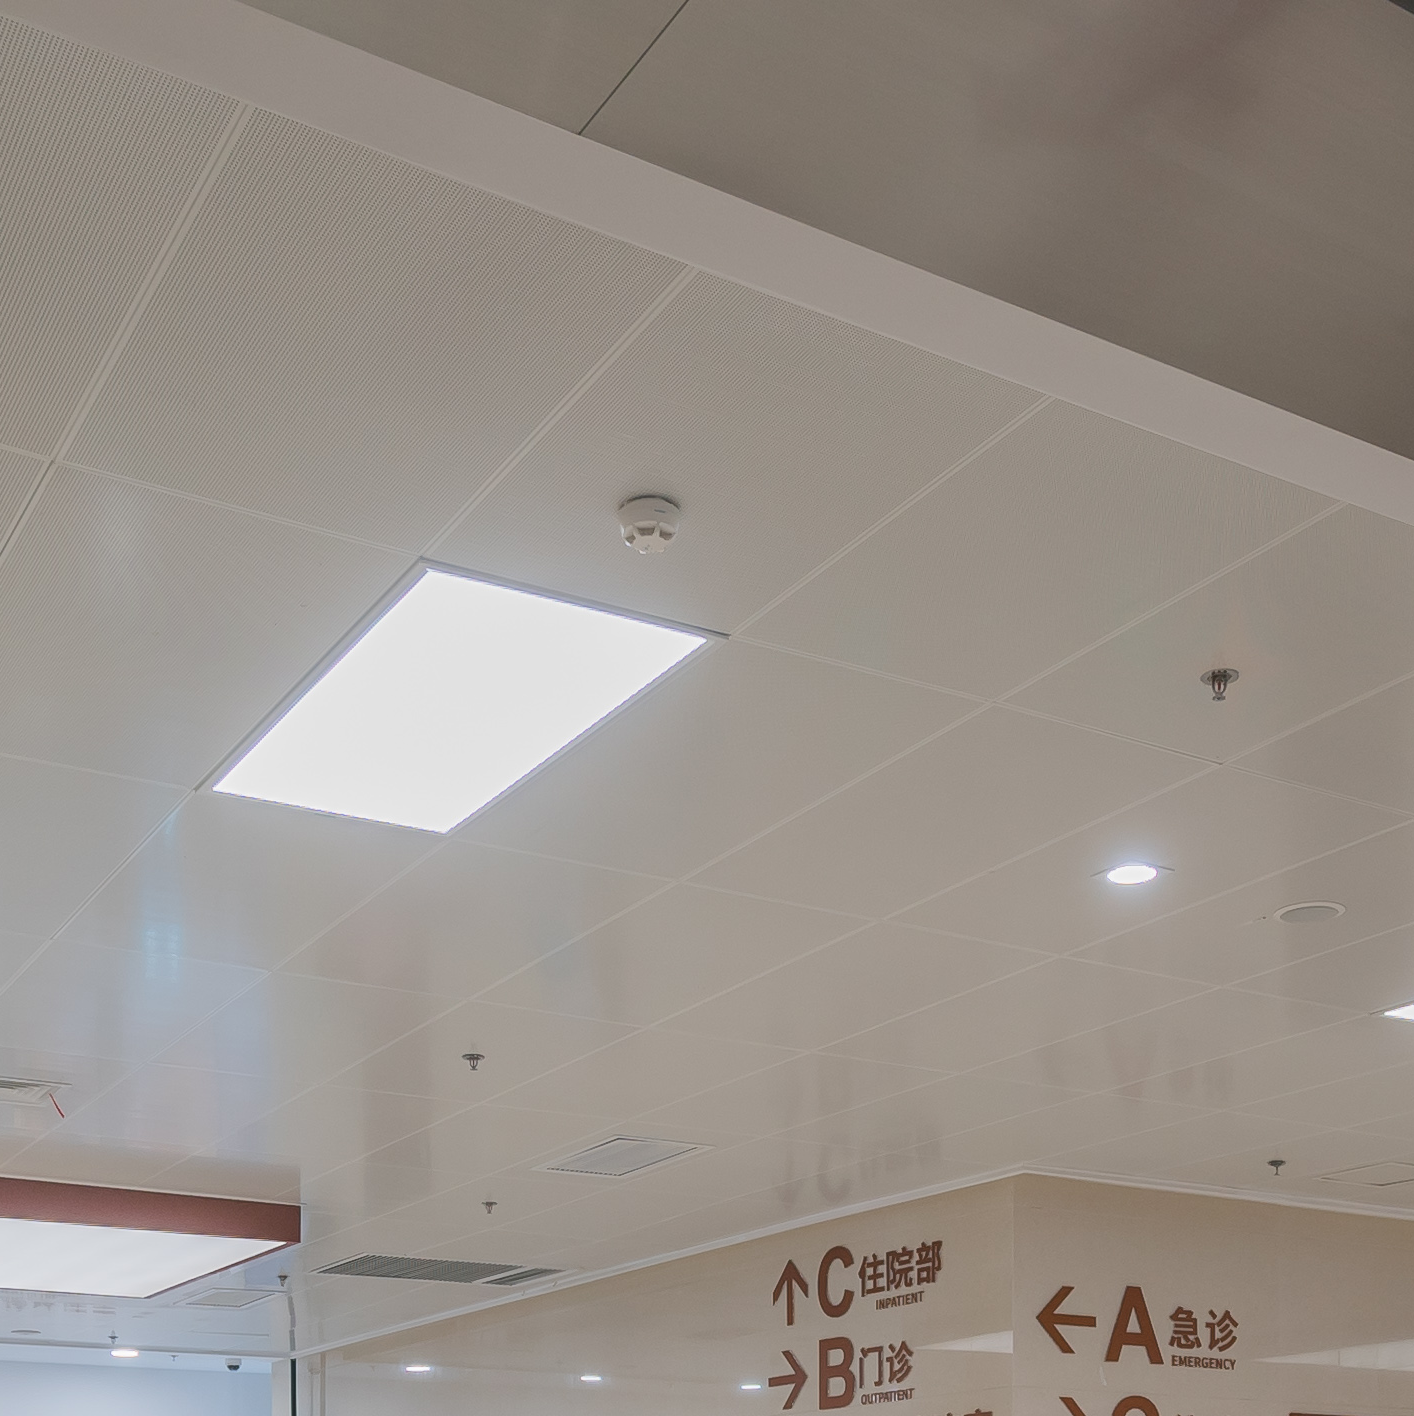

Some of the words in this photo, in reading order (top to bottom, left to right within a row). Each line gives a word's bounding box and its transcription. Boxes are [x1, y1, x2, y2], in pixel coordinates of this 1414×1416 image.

[817, 1245, 855, 1319] C
[858, 1239, 943, 1296] 住院部
[875, 1291, 925, 1311] INPATIENT
[1104, 1286, 1164, 1365] A
[1168, 1306, 1240, 1354] 急诊
[818, 1336, 856, 1410] B
[858, 1340, 914, 1389] 门诊
[1171, 1354, 1236, 1371] EMERGENCY
[861, 1387, 914, 1405] OUTPATIENT
